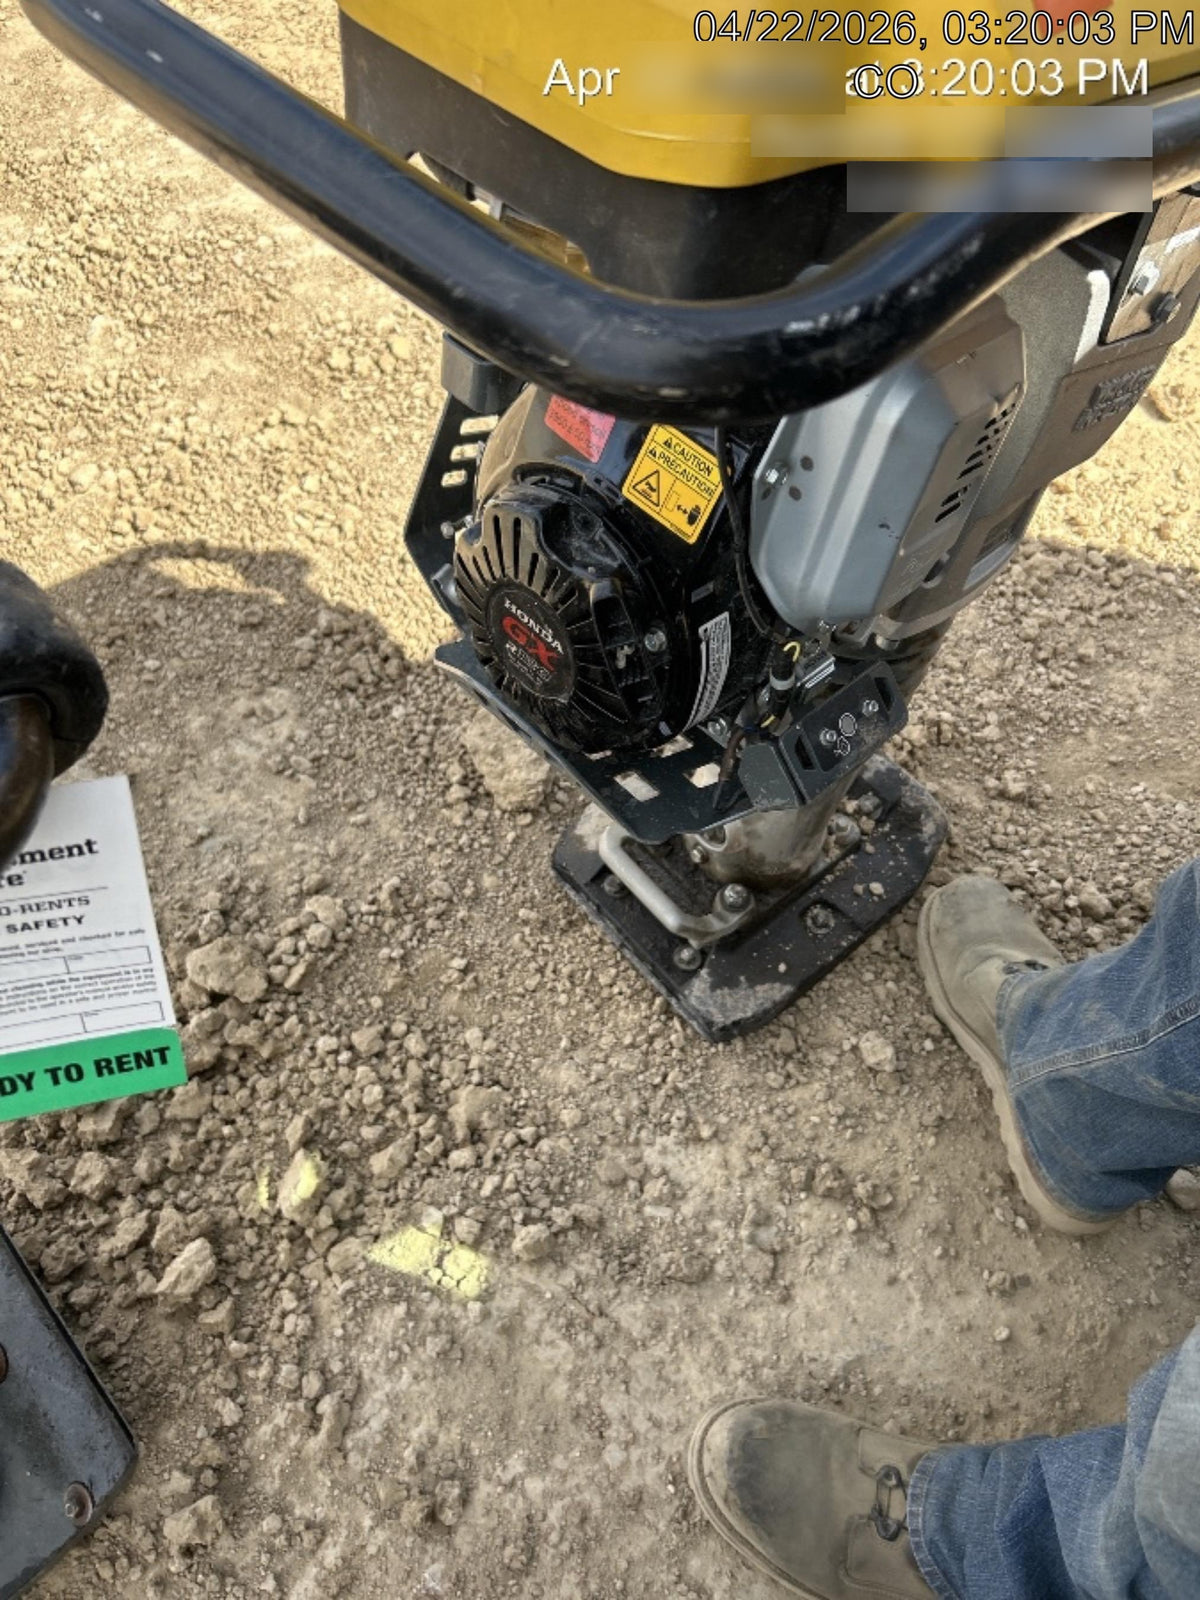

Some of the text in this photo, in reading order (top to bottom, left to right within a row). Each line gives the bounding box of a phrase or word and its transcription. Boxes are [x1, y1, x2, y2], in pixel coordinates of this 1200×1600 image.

[673, 442, 714, 477] CAUTION
[502, 616, 557, 674] GX
[504, 597, 564, 655] HONDA
[12, 838, 99, 866] ment
[6, 913, 85, 934] SAFETY
[44, 1062, 84, 1087] TO
[93, 1045, 170, 1078] RENT
